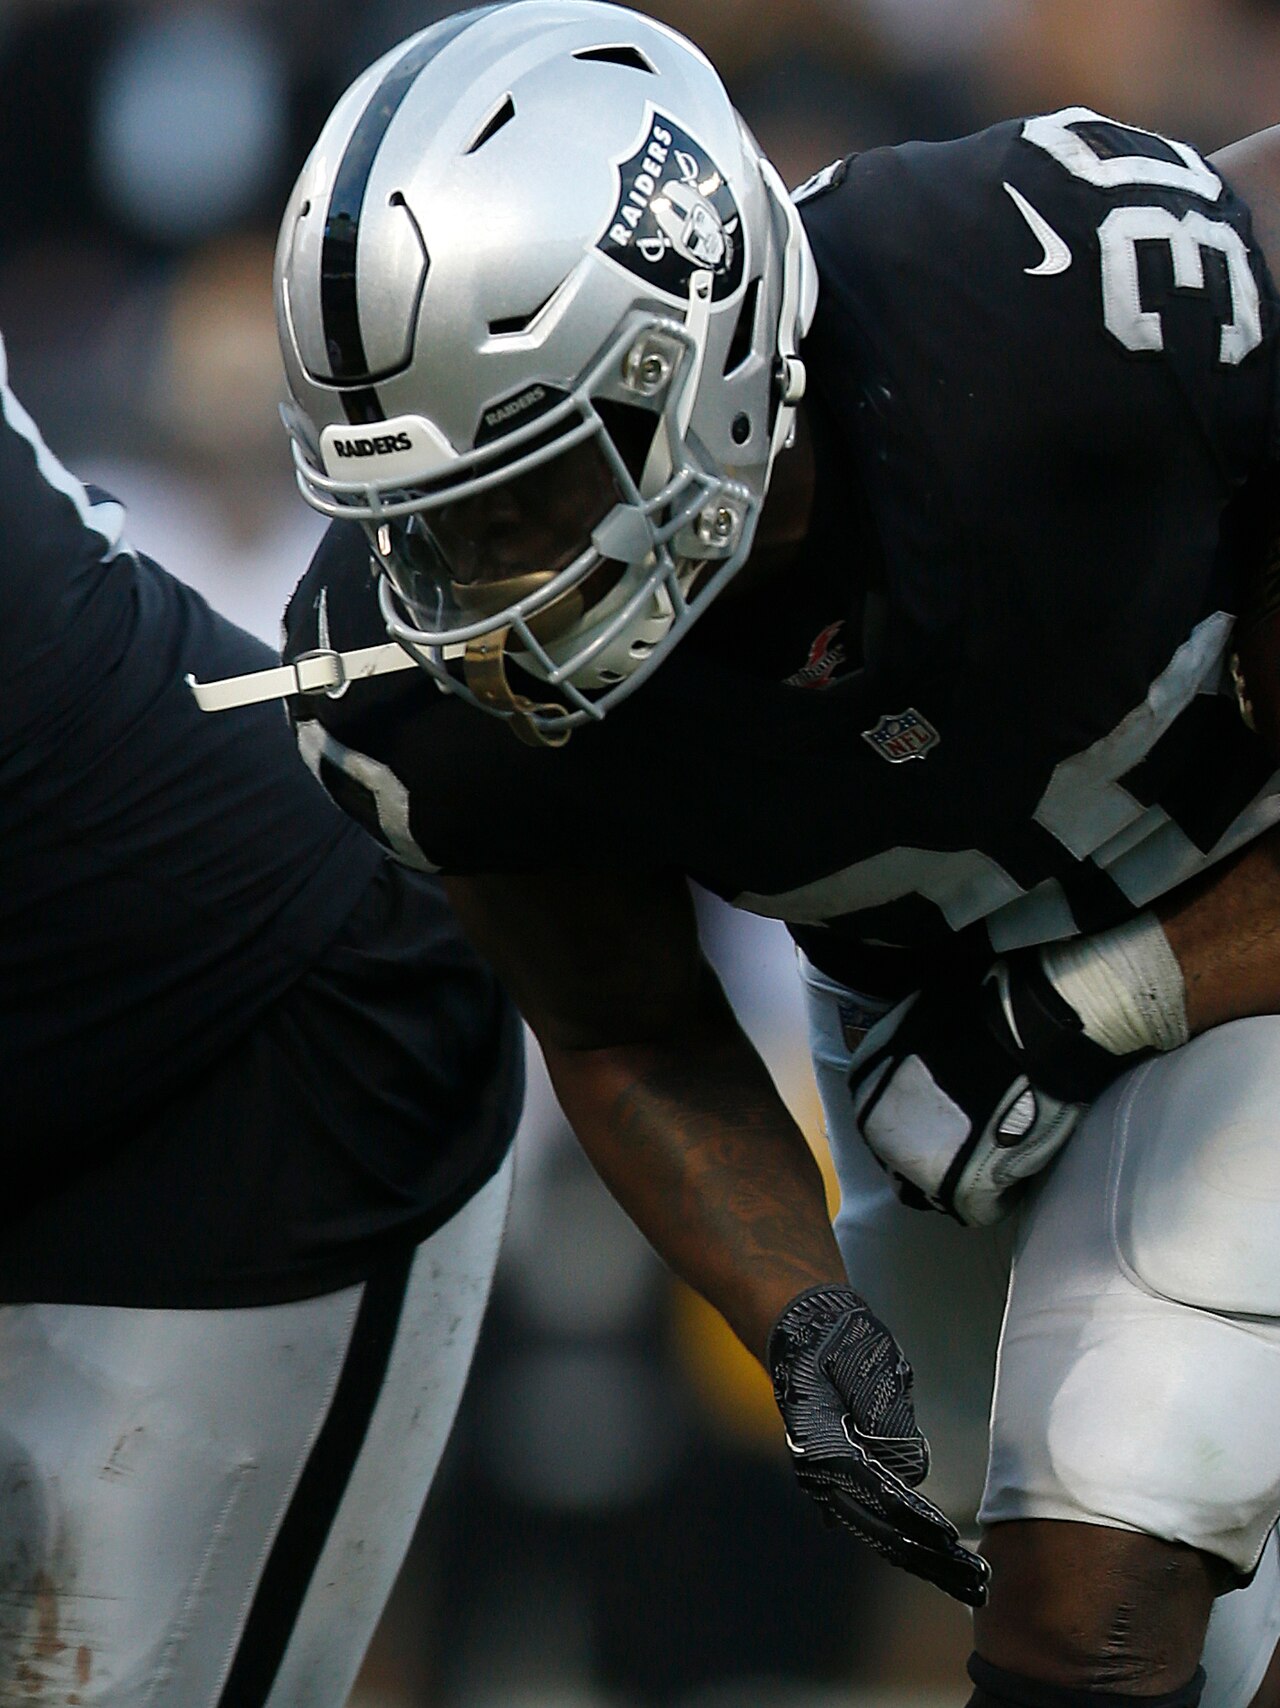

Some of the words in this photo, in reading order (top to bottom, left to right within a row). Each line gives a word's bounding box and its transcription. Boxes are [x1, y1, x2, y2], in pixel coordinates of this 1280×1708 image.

[608, 124, 674, 247] RAIDERS
[1021, 105, 1264, 366] 30
[484, 386, 546, 428] RAIDERS
[333, 431, 412, 459] RAIDERS
[887, 727, 928, 755] NFL
